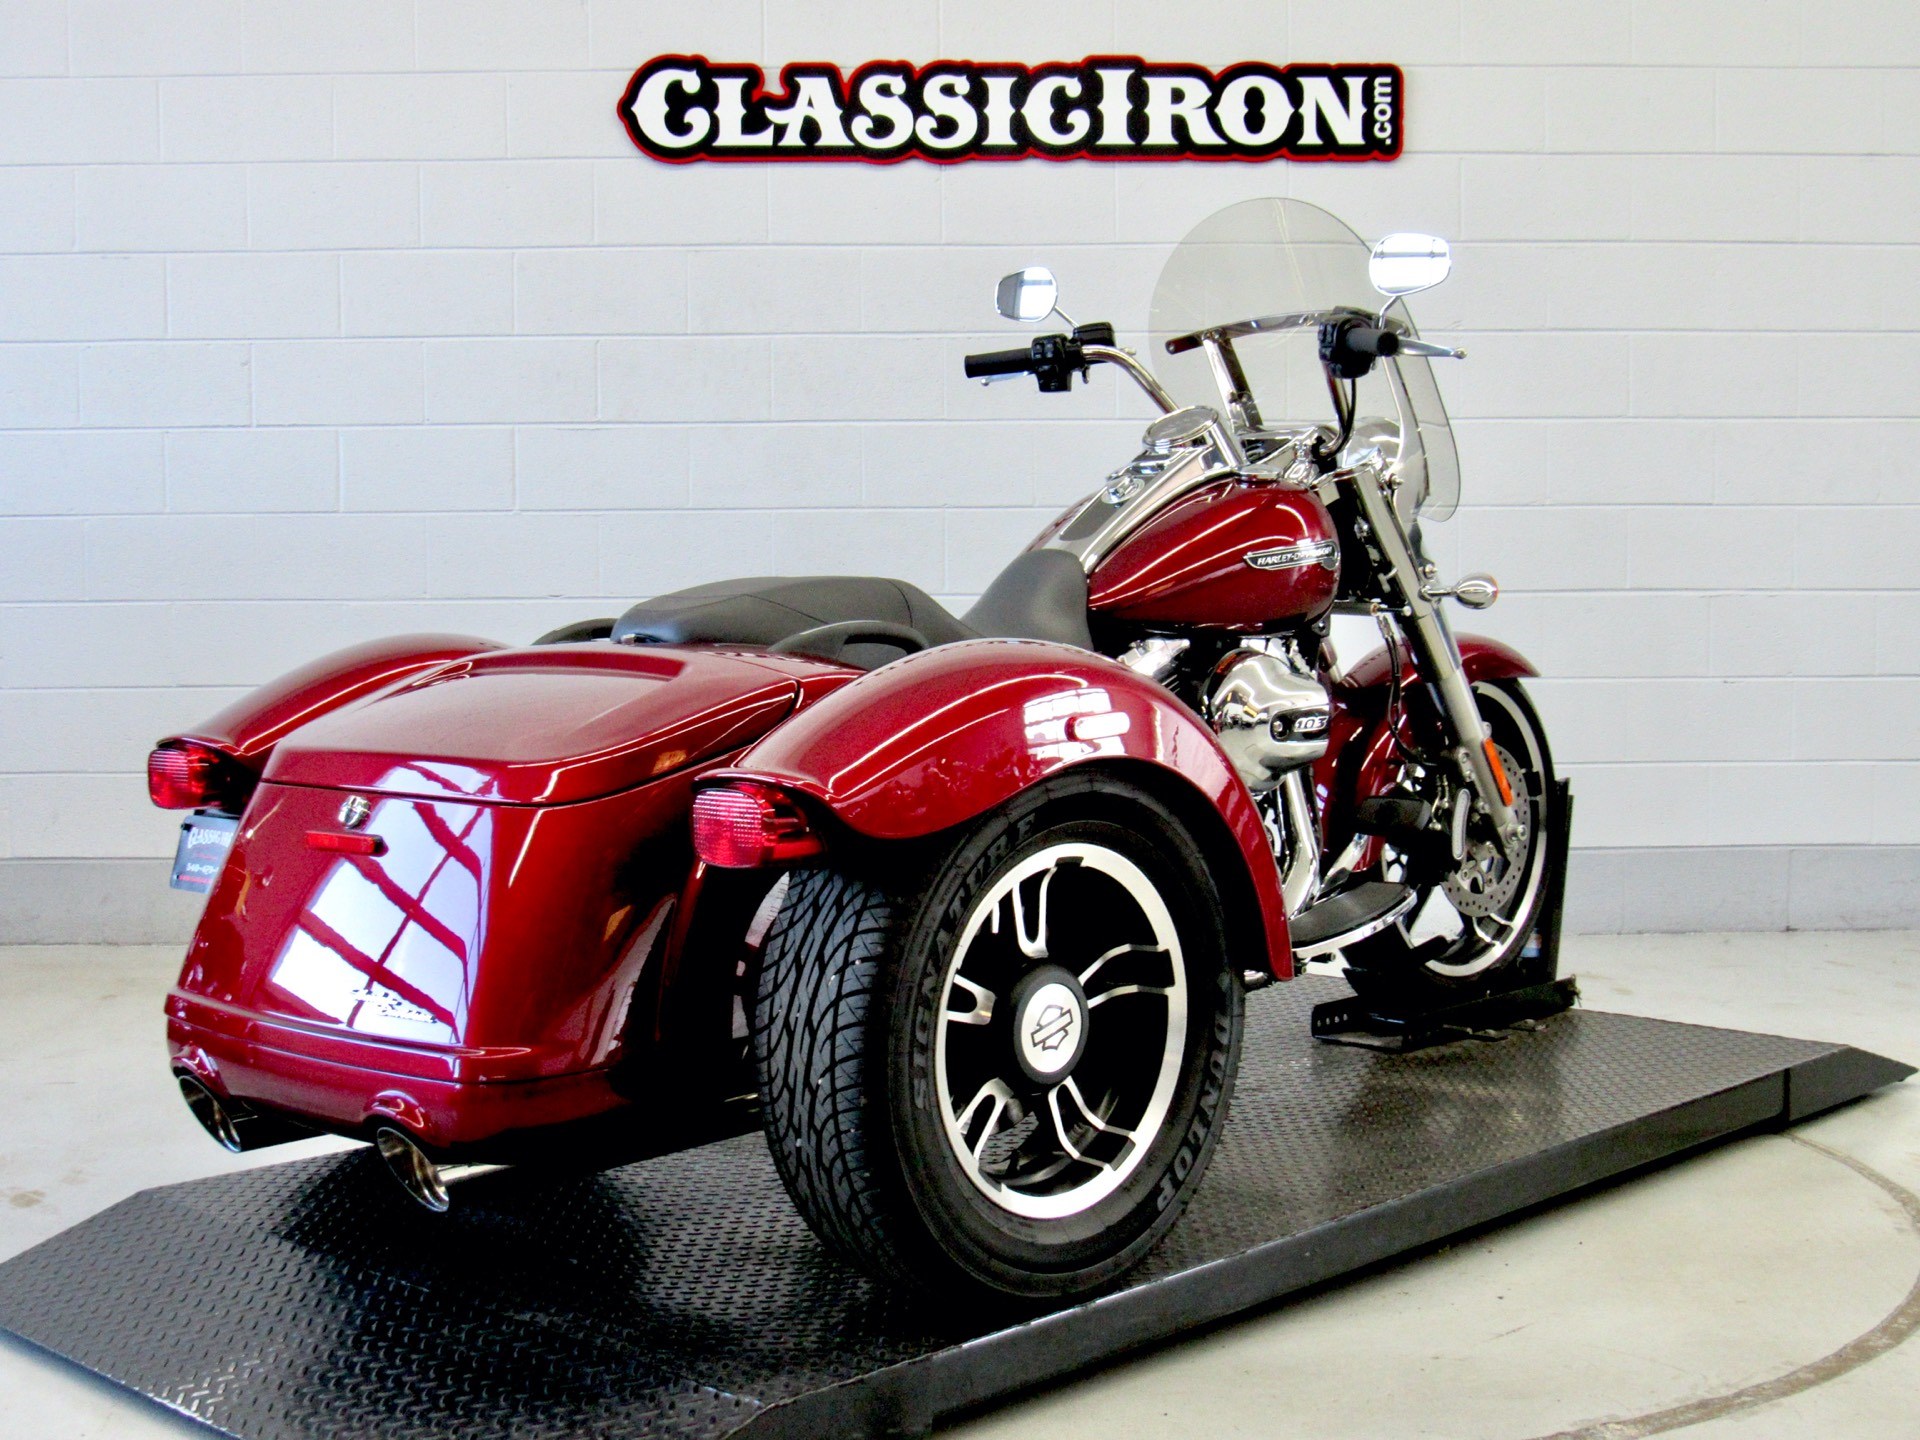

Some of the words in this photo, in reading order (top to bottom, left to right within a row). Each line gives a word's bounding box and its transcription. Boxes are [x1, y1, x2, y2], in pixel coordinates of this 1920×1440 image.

[1370, 75, 1392, 145] .com
[1295, 716, 1328, 732] 103
[188, 827, 220, 849] CLASSIC
[912, 811, 1037, 1110] SIGNATURE
[1157, 1008, 1230, 1212] DUNLOP
